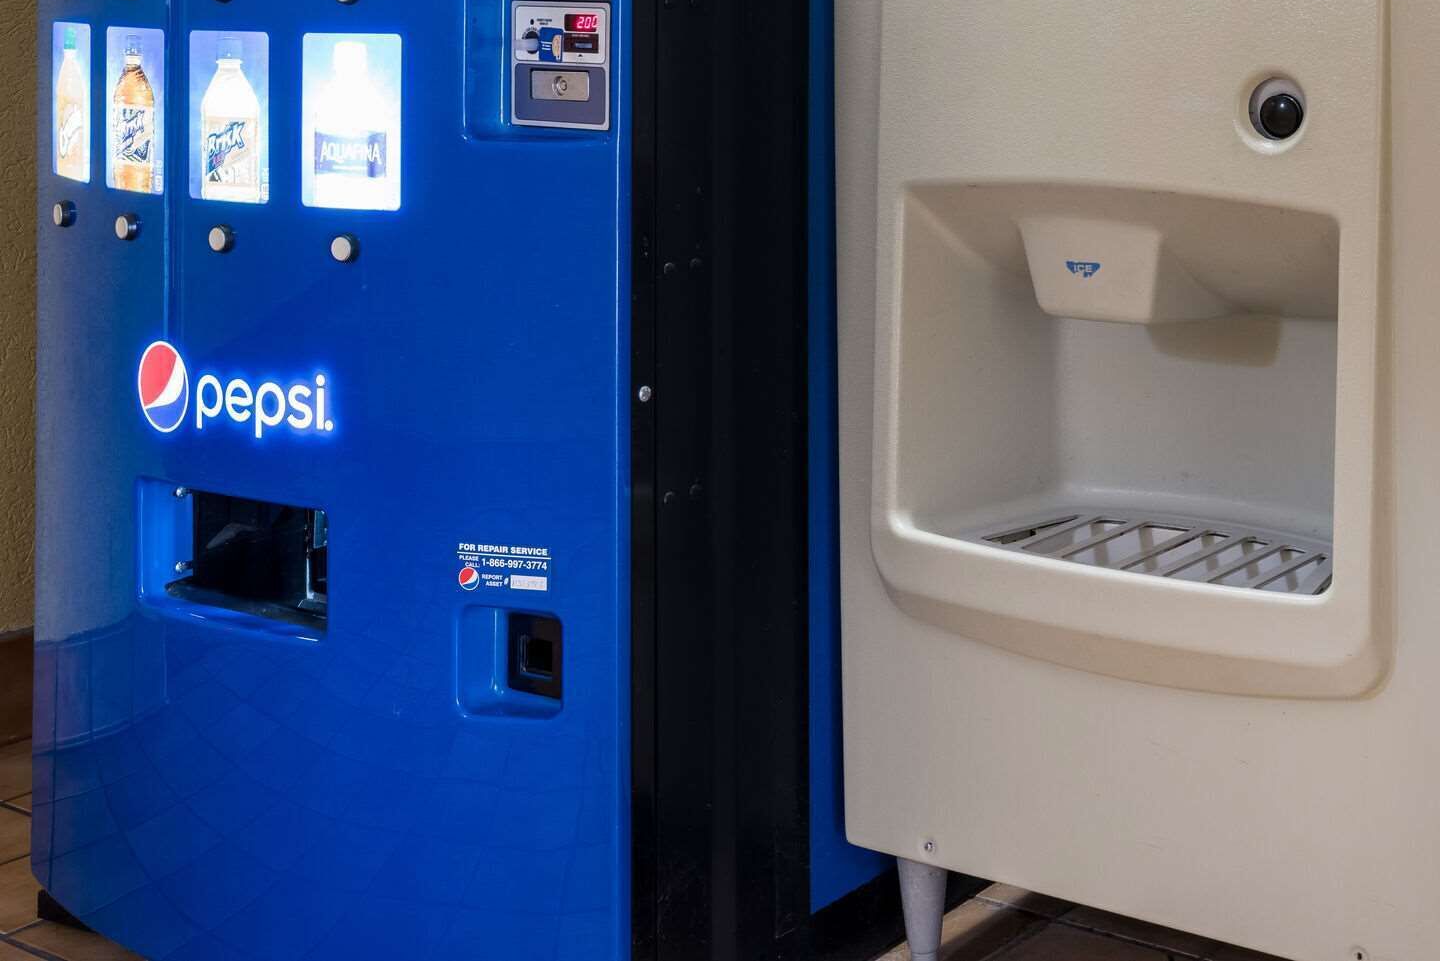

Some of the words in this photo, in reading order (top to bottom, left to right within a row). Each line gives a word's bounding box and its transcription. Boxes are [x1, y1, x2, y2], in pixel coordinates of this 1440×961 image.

[459, 543, 475, 551] FOR
[478, 545, 509, 553] REPAIR
[511, 547, 548, 556] SERVICE
[482, 558, 547, 571] 1-866-997-3774
